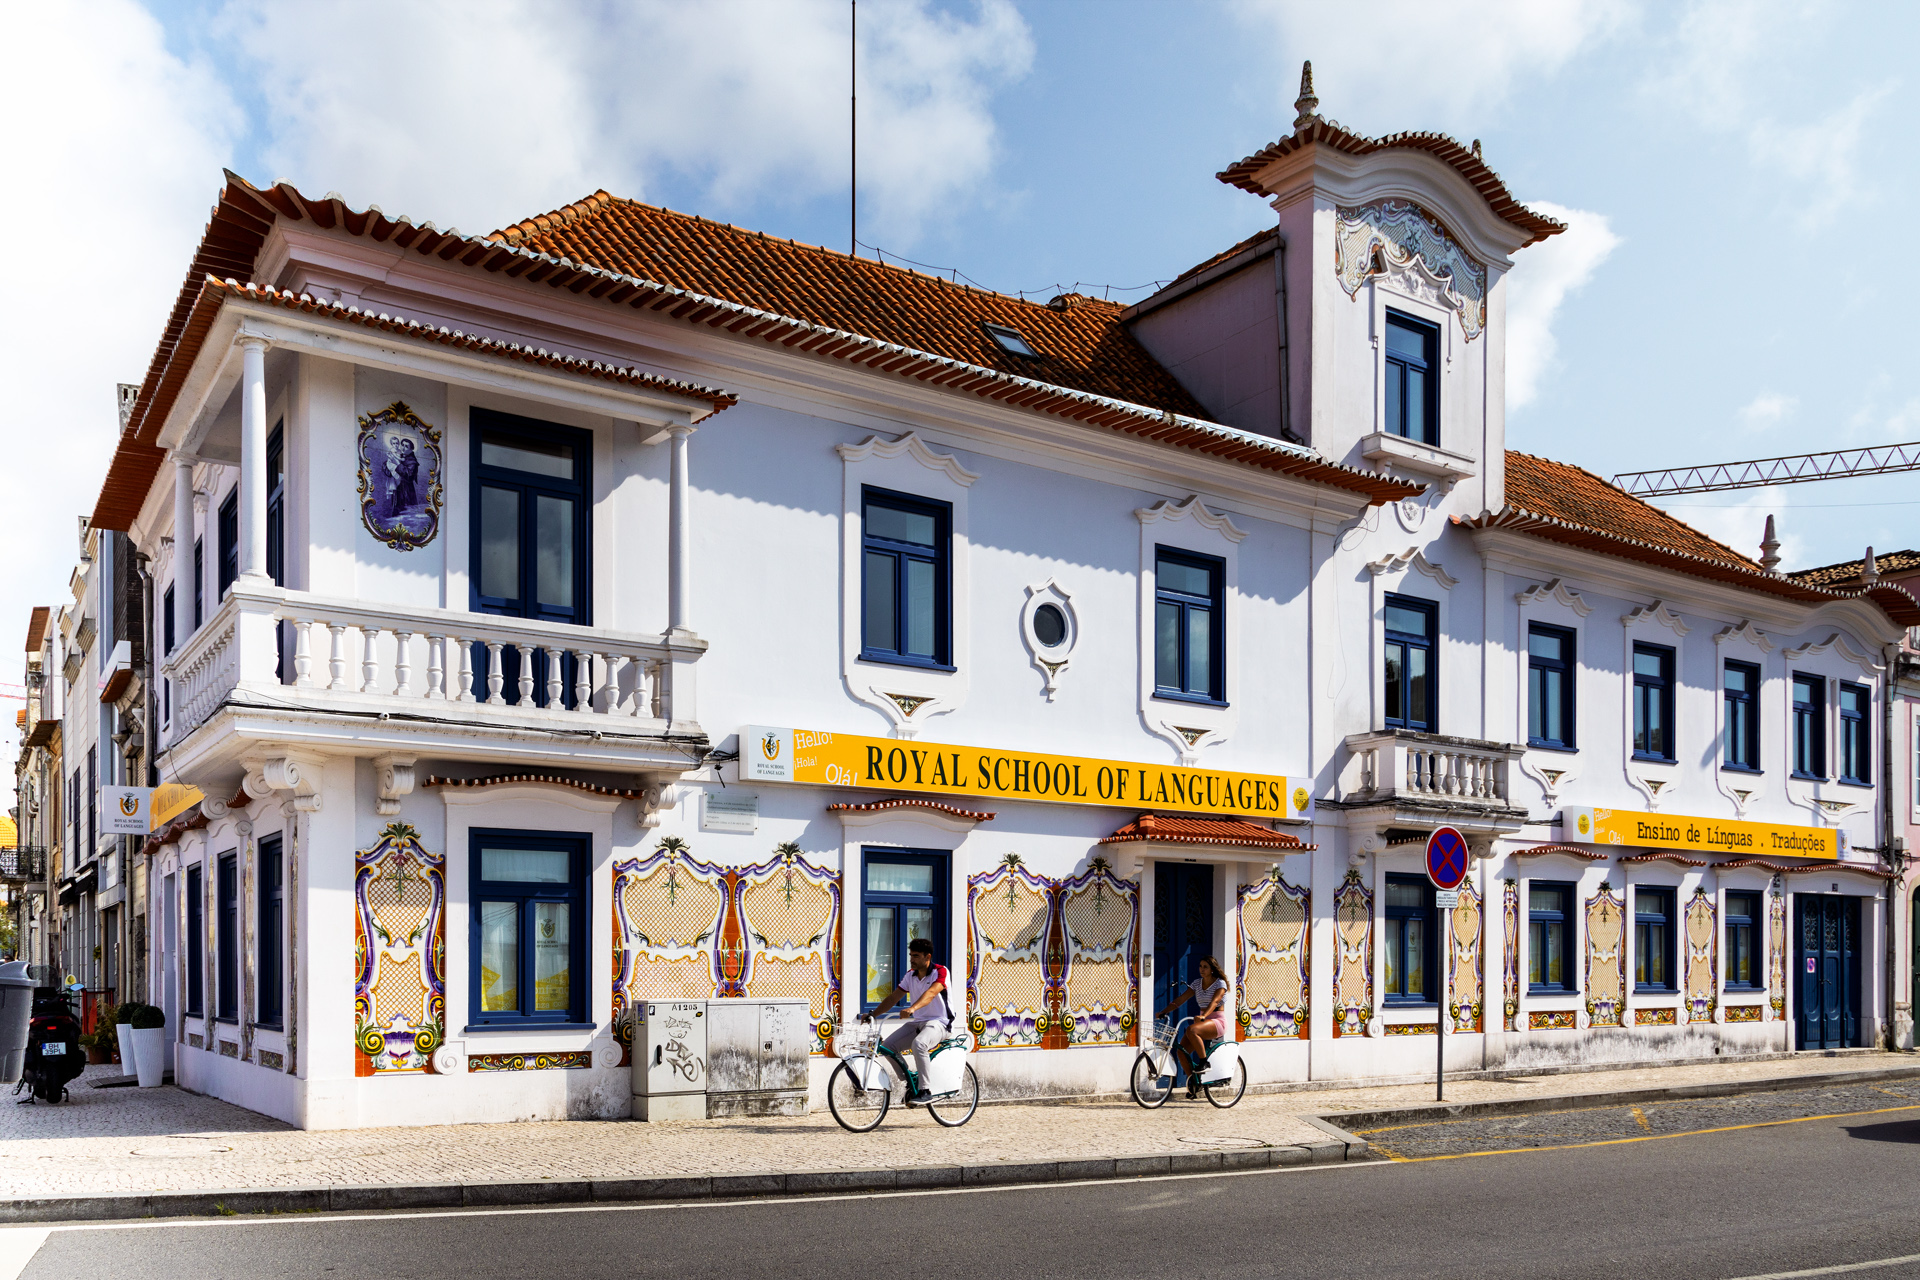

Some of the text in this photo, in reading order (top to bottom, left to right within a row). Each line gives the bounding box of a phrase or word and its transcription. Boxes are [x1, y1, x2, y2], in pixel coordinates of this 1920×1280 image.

[795, 731, 833, 750] Hello!
[866, 745, 1280, 812] ROYAL SCHOOL OF LANGUAGES
[1637, 821, 1680, 841] Ensino
[1686, 823, 1701, 843] de
[1706, 826, 1753, 850] Línguas
[1771, 832, 1826, 856] Traduções
